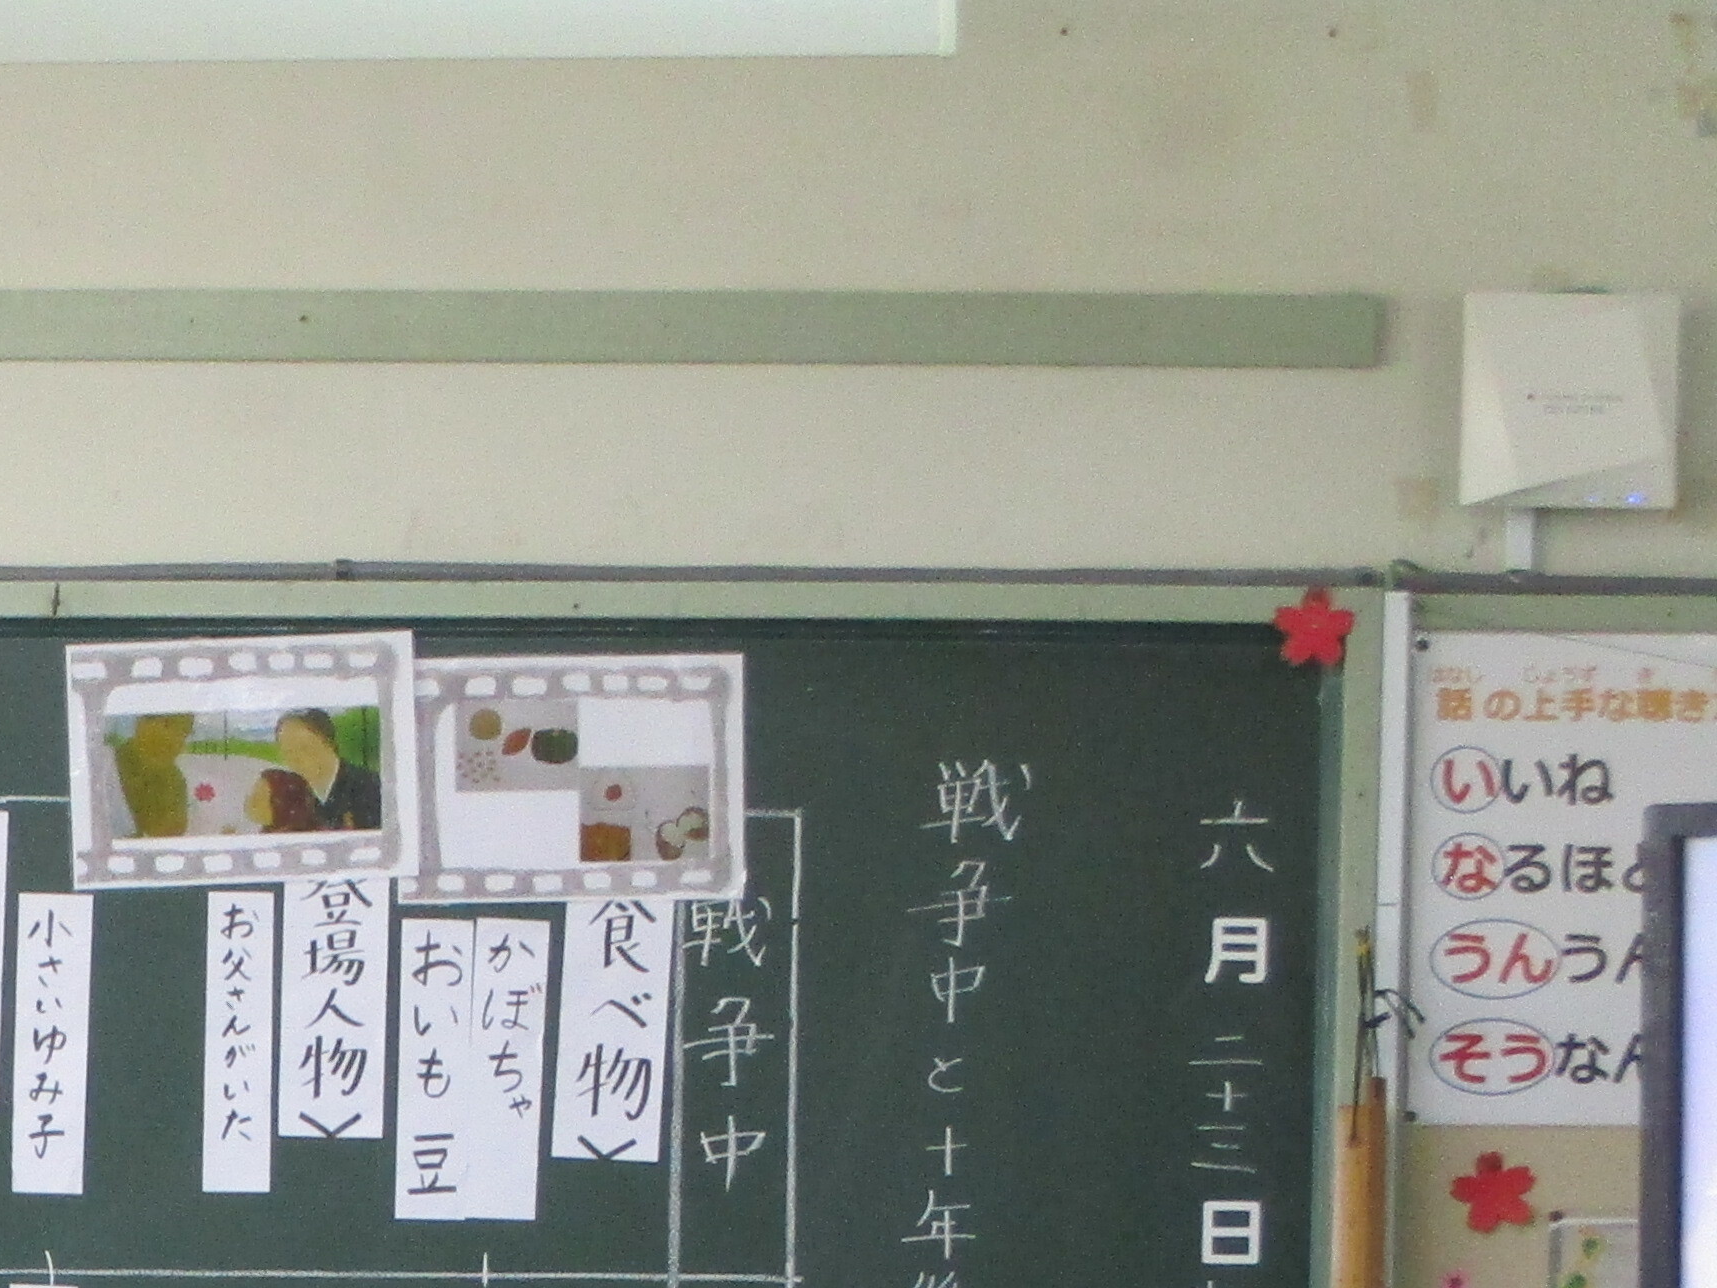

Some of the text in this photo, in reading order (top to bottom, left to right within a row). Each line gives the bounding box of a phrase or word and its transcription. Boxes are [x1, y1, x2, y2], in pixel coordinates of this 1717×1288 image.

[1441, 753, 1614, 806] いいね
[26, 909, 74, 1160] 小さいゆみ子
[218, 902, 260, 1142] お父さんがいた
[481, 931, 544, 1120] かぼちゃ
[682, 896, 774, 1193] 戦争中
